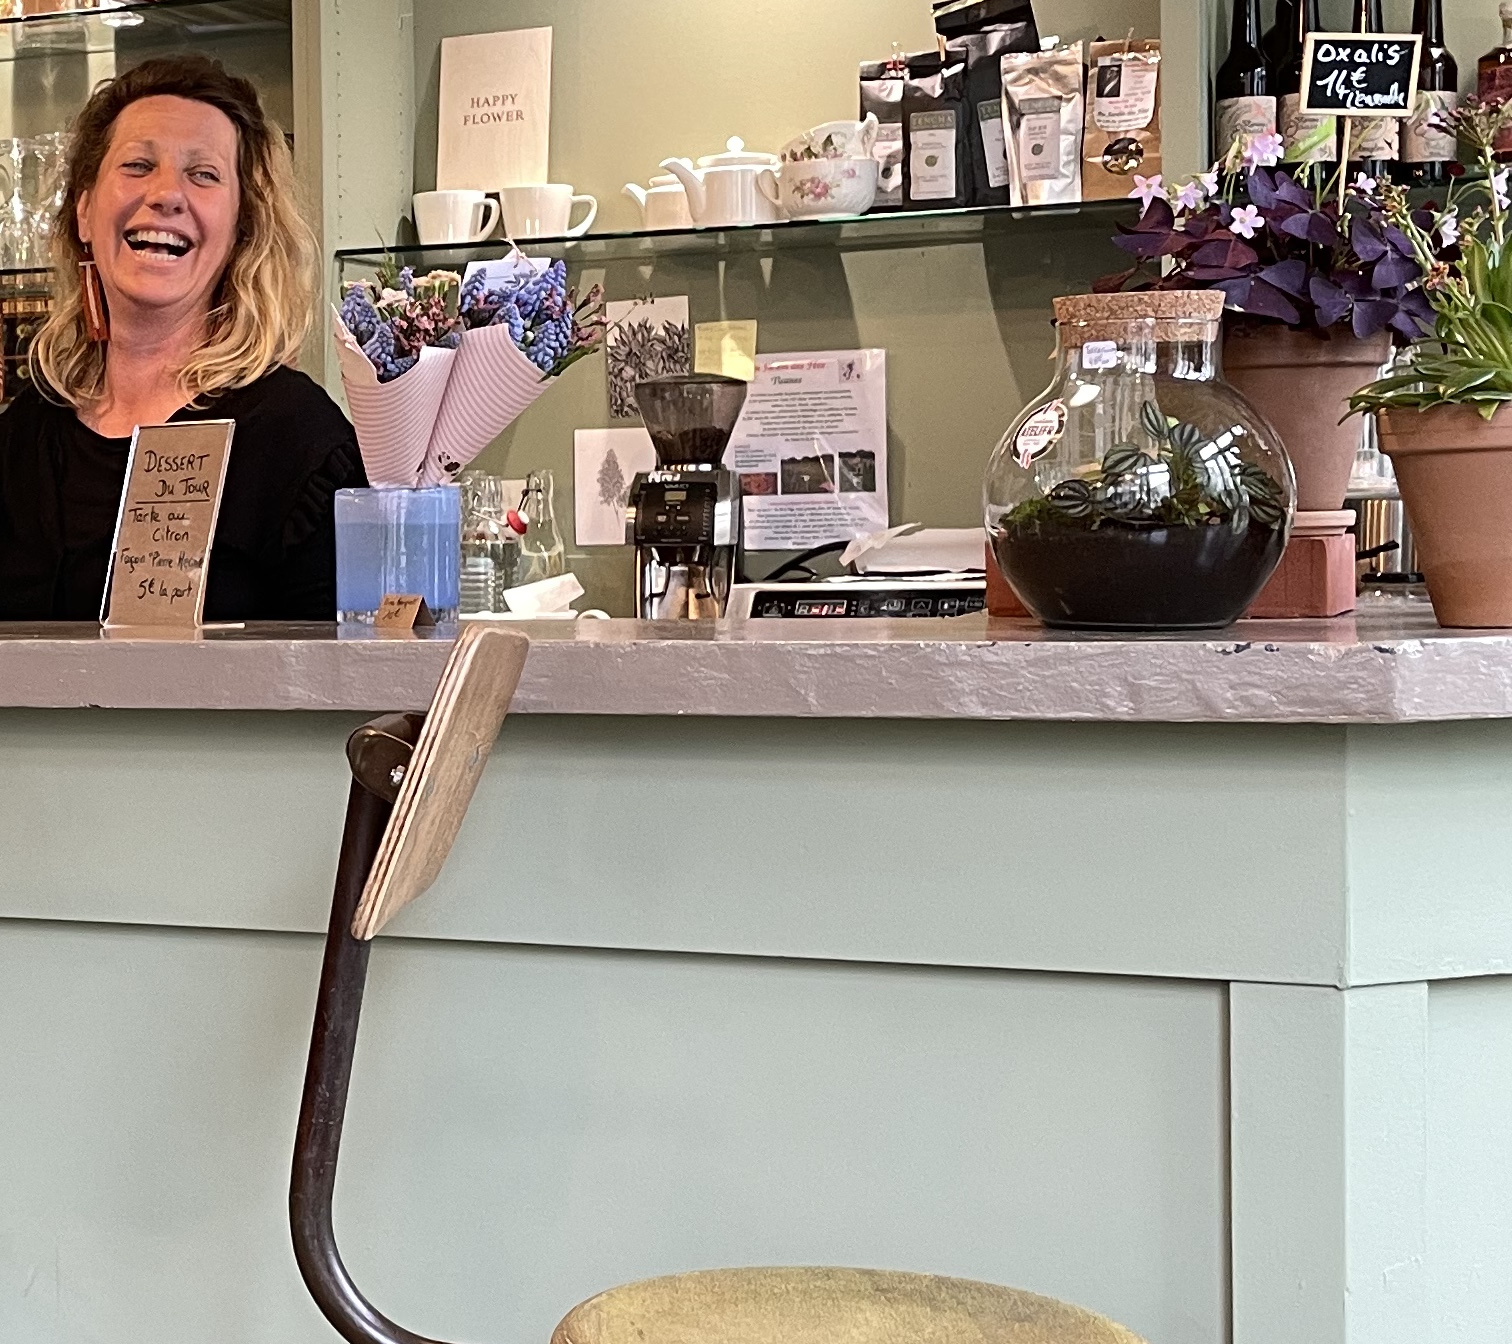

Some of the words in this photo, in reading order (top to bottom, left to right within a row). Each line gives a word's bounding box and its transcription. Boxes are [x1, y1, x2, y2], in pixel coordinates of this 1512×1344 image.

[470, 93, 519, 109] HAPPY
[463, 110, 525, 126] FLOWER
[144, 450, 210, 472] DESSERT
[168, 512, 190, 521] au
[152, 525, 189, 542] Citron
[170, 580, 192, 604] part
